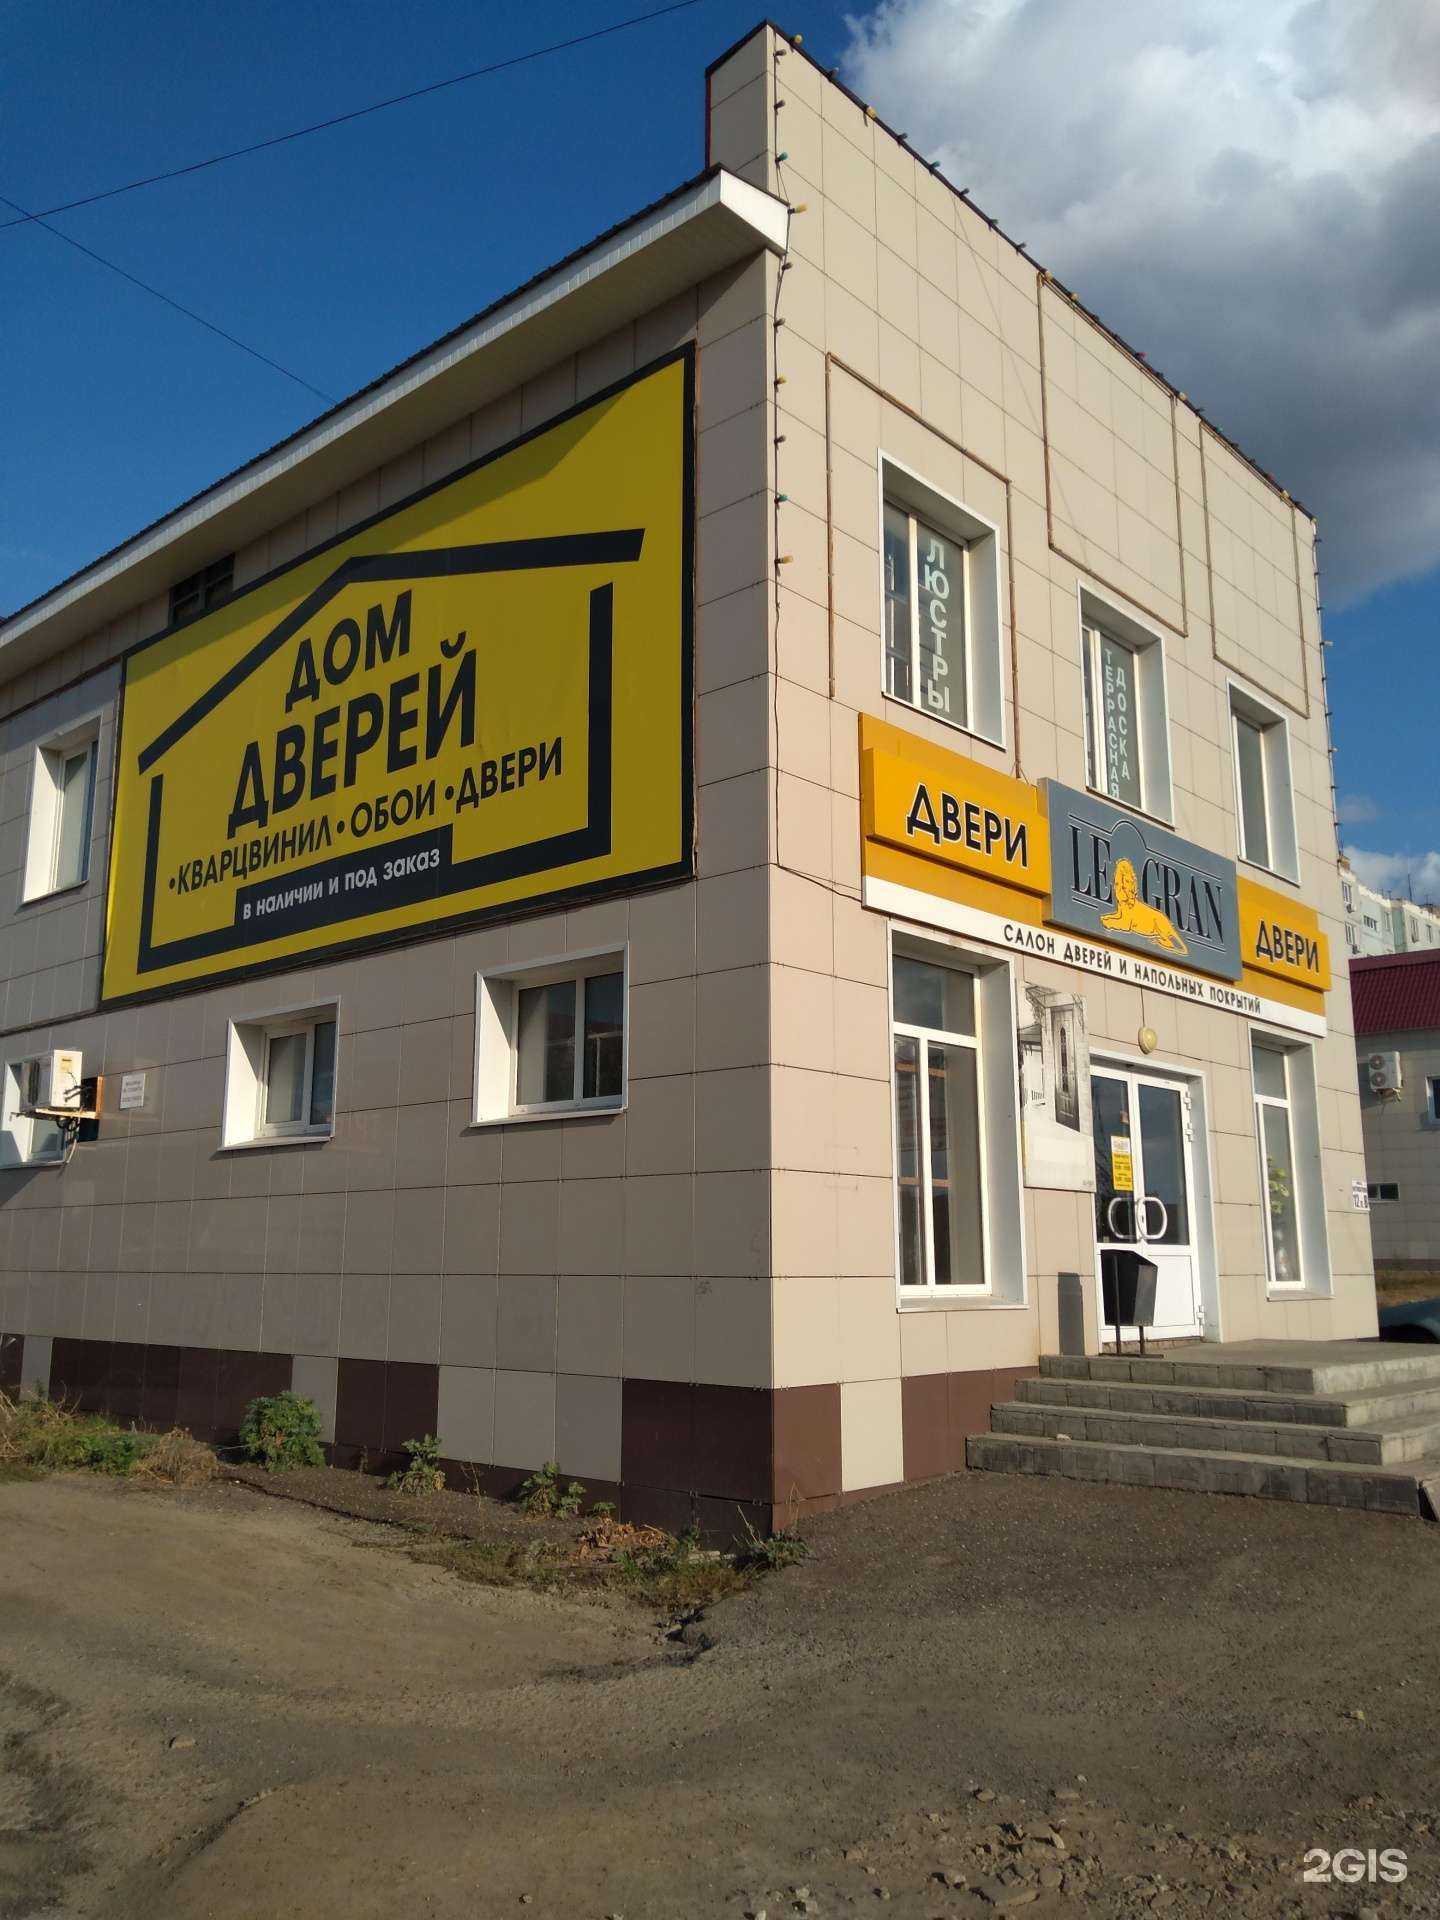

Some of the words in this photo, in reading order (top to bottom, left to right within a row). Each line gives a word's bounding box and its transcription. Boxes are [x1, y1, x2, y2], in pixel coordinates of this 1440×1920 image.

[285, 590, 411, 712] ДОМ
[924, 538, 950, 712] ЛЮСТРЫ
[227, 631, 476, 838] ДВЕРЕЙ
[1105, 648, 1120, 800] ТЕРРАСНАЯ
[1116, 667, 1130, 781] ДОСКА
[178, 815, 332, 895] КВАРЦВИНИЛ
[350, 779, 436, 838] ОБОИ
[456, 737, 562, 812] ДВЕРИ
[906, 783, 1028, 869] ДВЕРИ
[256, 882, 323, 916] наличии
[345, 865, 377, 892] под
[383, 848, 440, 881] заказ
[1069, 824, 1113, 905] LE
[1142, 858, 1224, 944] GRAN
[1003, 924, 1055, 955] САЛОН
[1063, 942, 1112, 972] ДВЕРЕЙ
[1119, 959, 1128, 975] И
[1135, 961, 1204, 998] НАПОЛЬНЫХ
[1209, 985, 1261, 1015] ПОКРЫТИЙ
[1256, 920, 1319, 973] ДВЕРИ
